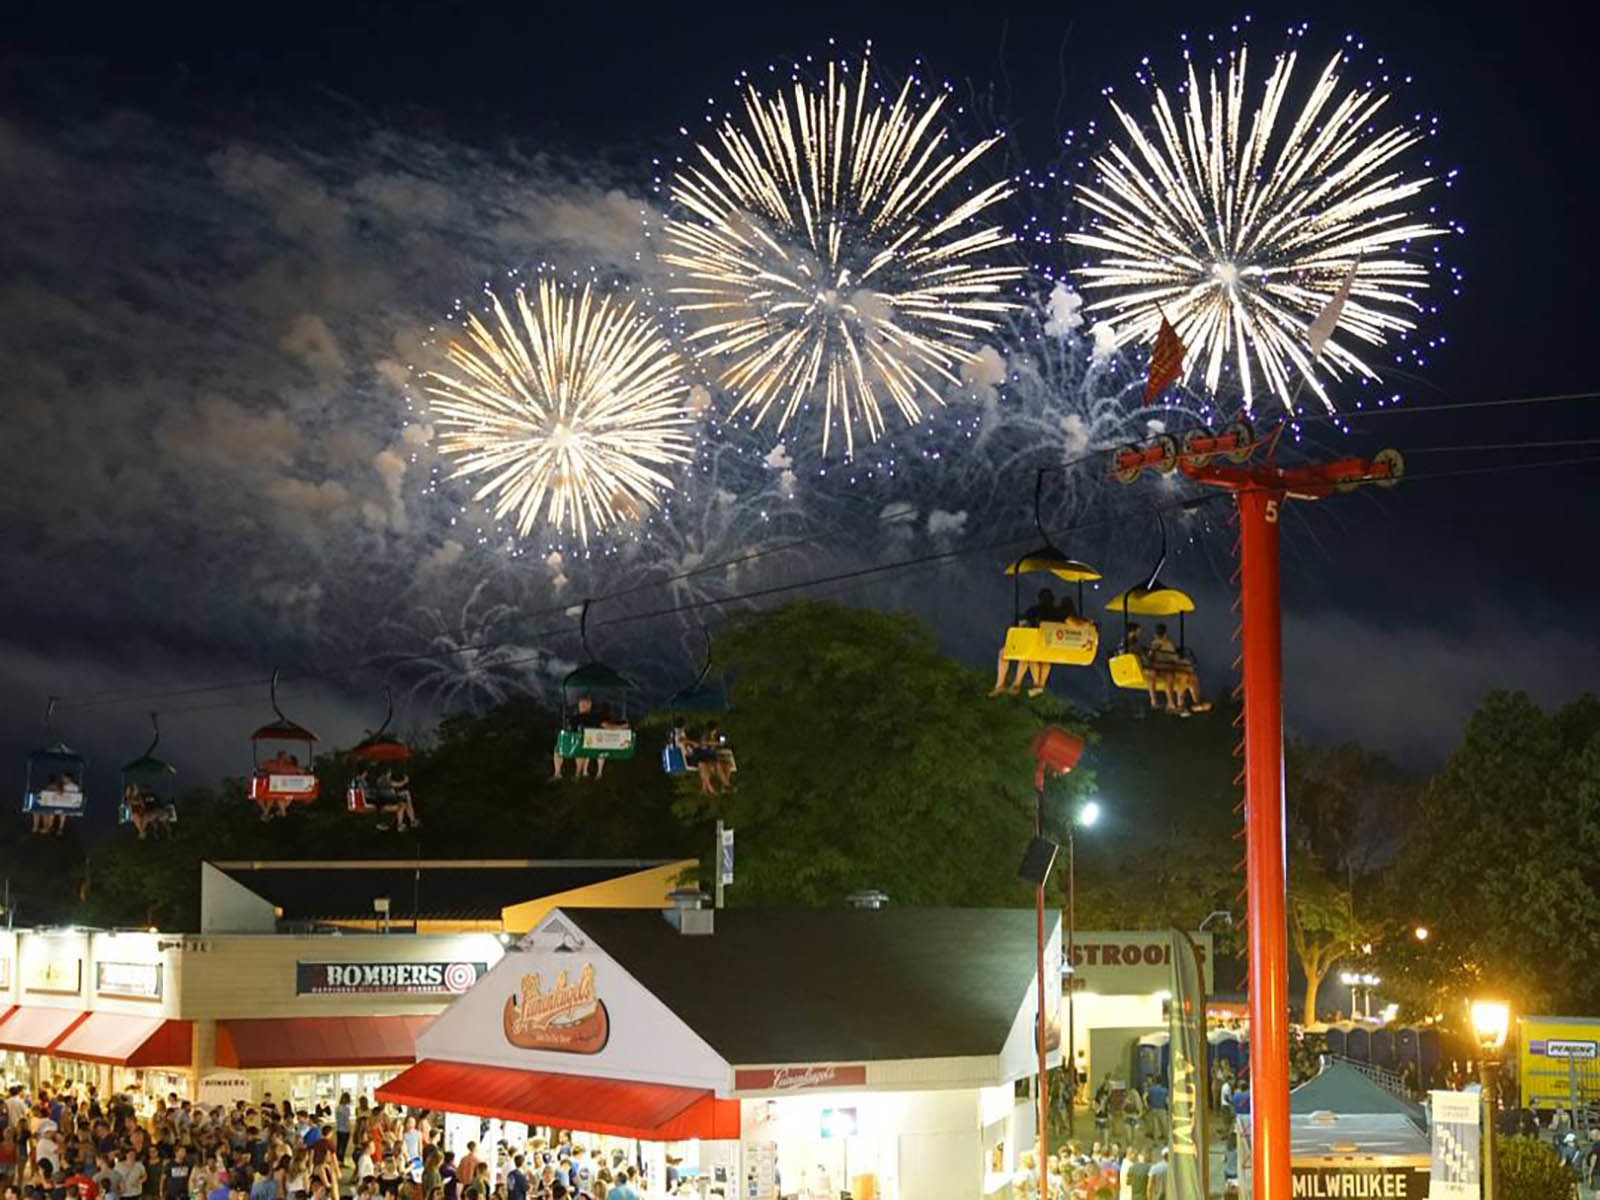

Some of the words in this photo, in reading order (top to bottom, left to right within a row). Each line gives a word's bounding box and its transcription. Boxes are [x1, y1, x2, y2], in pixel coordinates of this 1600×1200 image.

[1265, 500, 1277, 522] 5
[327, 965, 442, 986] BOMBERS
[1292, 1174, 1407, 1197] MILWAUKEE
